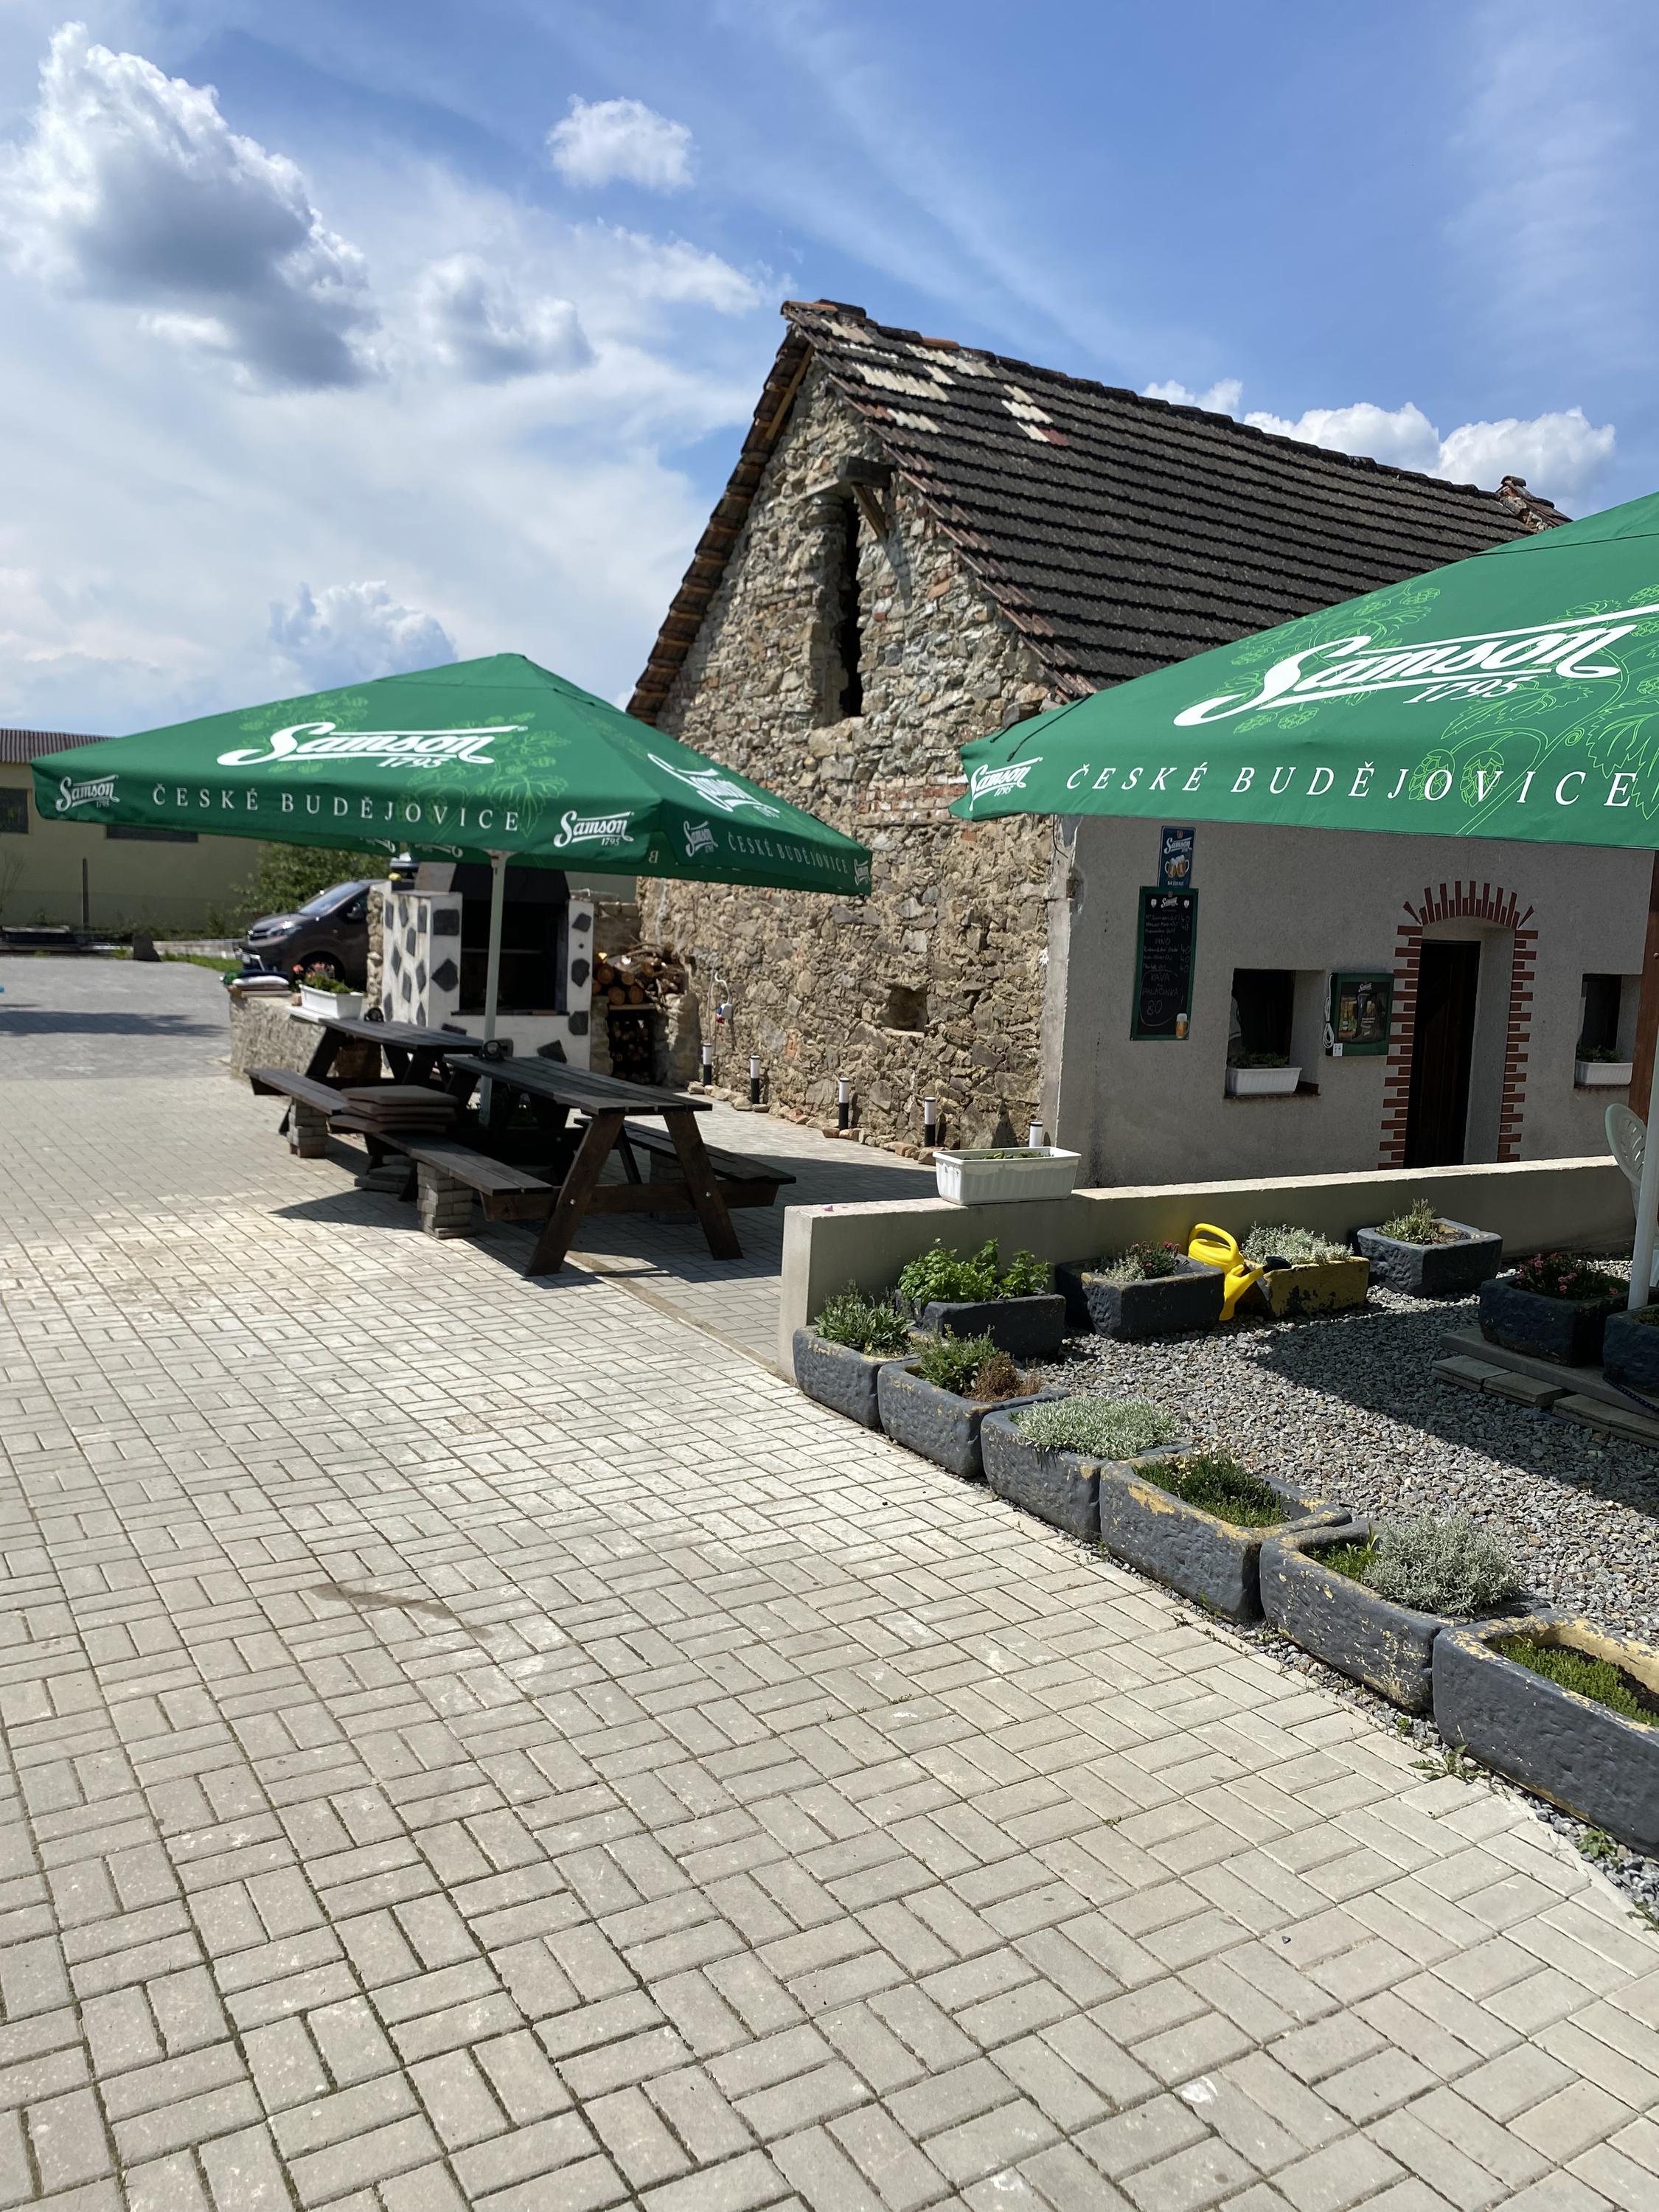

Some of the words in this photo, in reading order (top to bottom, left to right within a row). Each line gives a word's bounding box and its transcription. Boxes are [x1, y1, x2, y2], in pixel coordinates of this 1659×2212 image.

[1174, 619, 1641, 726] Samson
[1402, 675, 1537, 704] 1795
[217, 722, 520, 765] Samson
[376, 757, 447, 768] 1795
[55, 774, 120, 811] Samson
[969, 757, 1043, 811] Samson
[1066, 762, 1208, 792] ČESKÉ
[1230, 761, 1638, 807] BUDĚJOVICE
[153, 783, 259, 810] ČESKÉ
[281, 793, 519, 831] BUDĚJOVICE
[554, 810, 634, 847] Samson
[601, 838, 621, 846] 1795
[1164, 836, 1192, 855] Samson
[728, 832, 773, 857] ČESKÉ
[776, 844, 848, 874] BUDĚJOVICE
